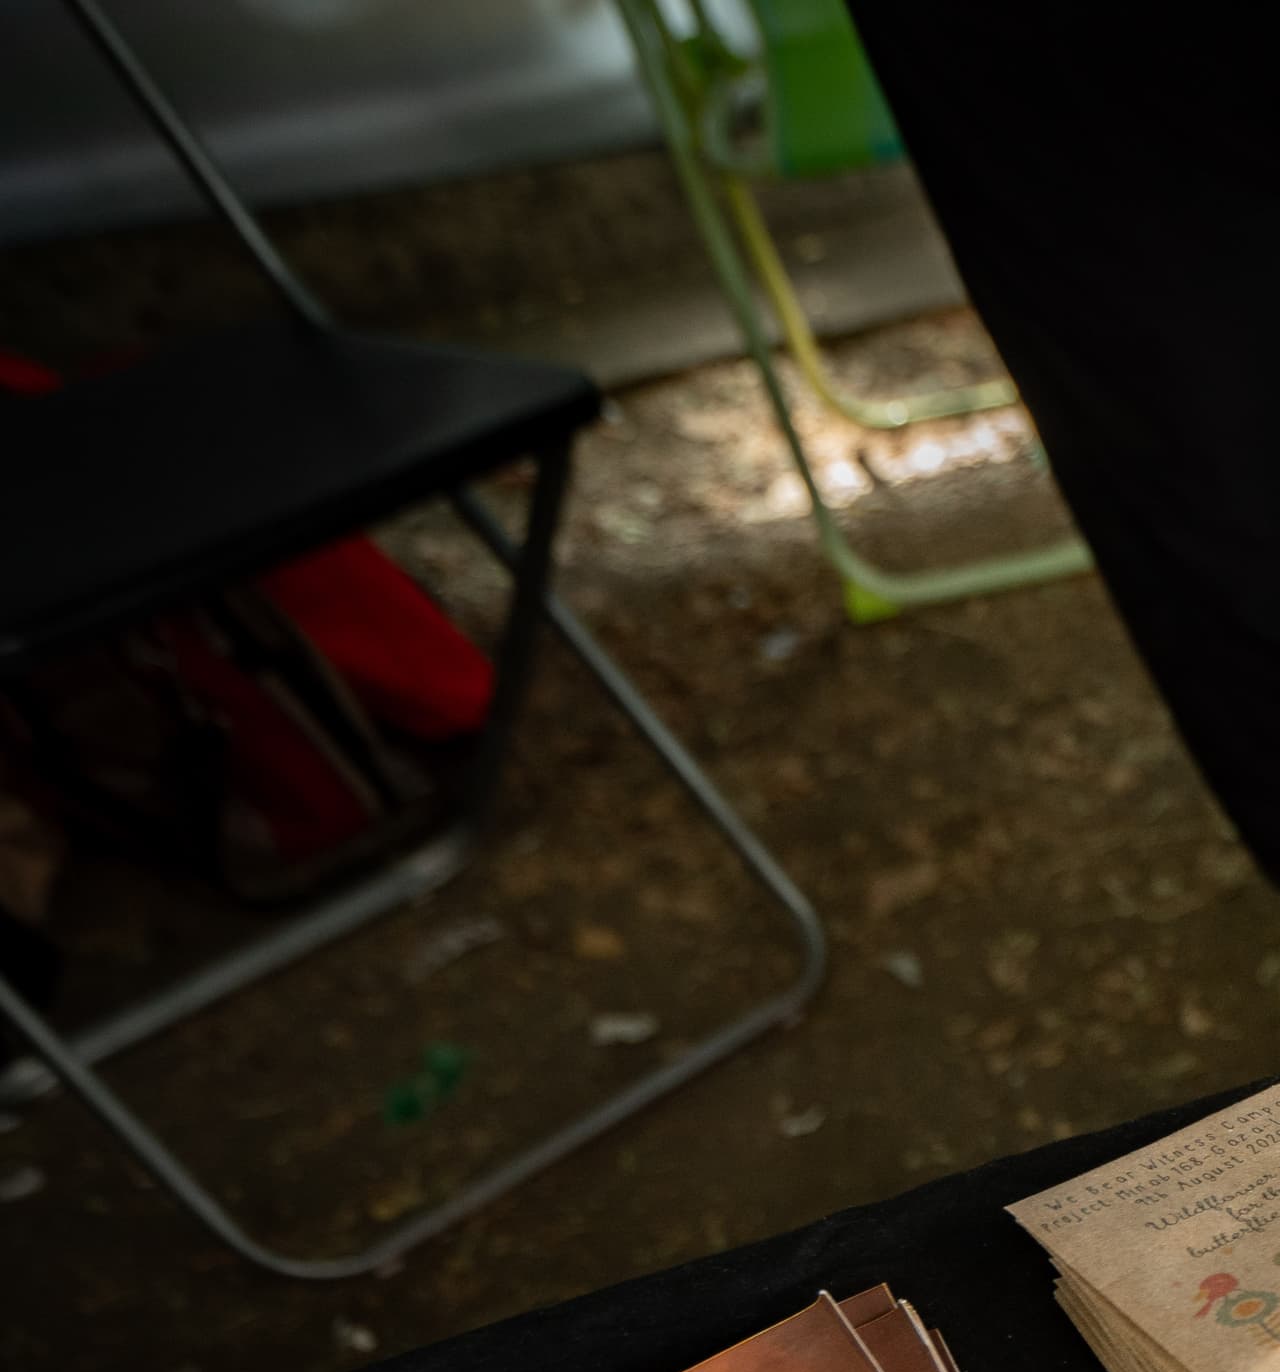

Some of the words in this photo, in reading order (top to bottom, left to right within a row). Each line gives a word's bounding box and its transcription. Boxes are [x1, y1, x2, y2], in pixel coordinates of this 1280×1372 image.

[1043, 1195, 1077, 1210] We
[1084, 1171, 1134, 1195] Bear
[1138, 1134, 1216, 1169] Witness
[1134, 1191, 1168, 1206] 9th
[1176, 1156, 1244, 1191] August
[1040, 1199, 1110, 1232] Project
[1145, 1174, 1277, 1232] Wildflower
[1225, 1202, 1261, 1221] for
